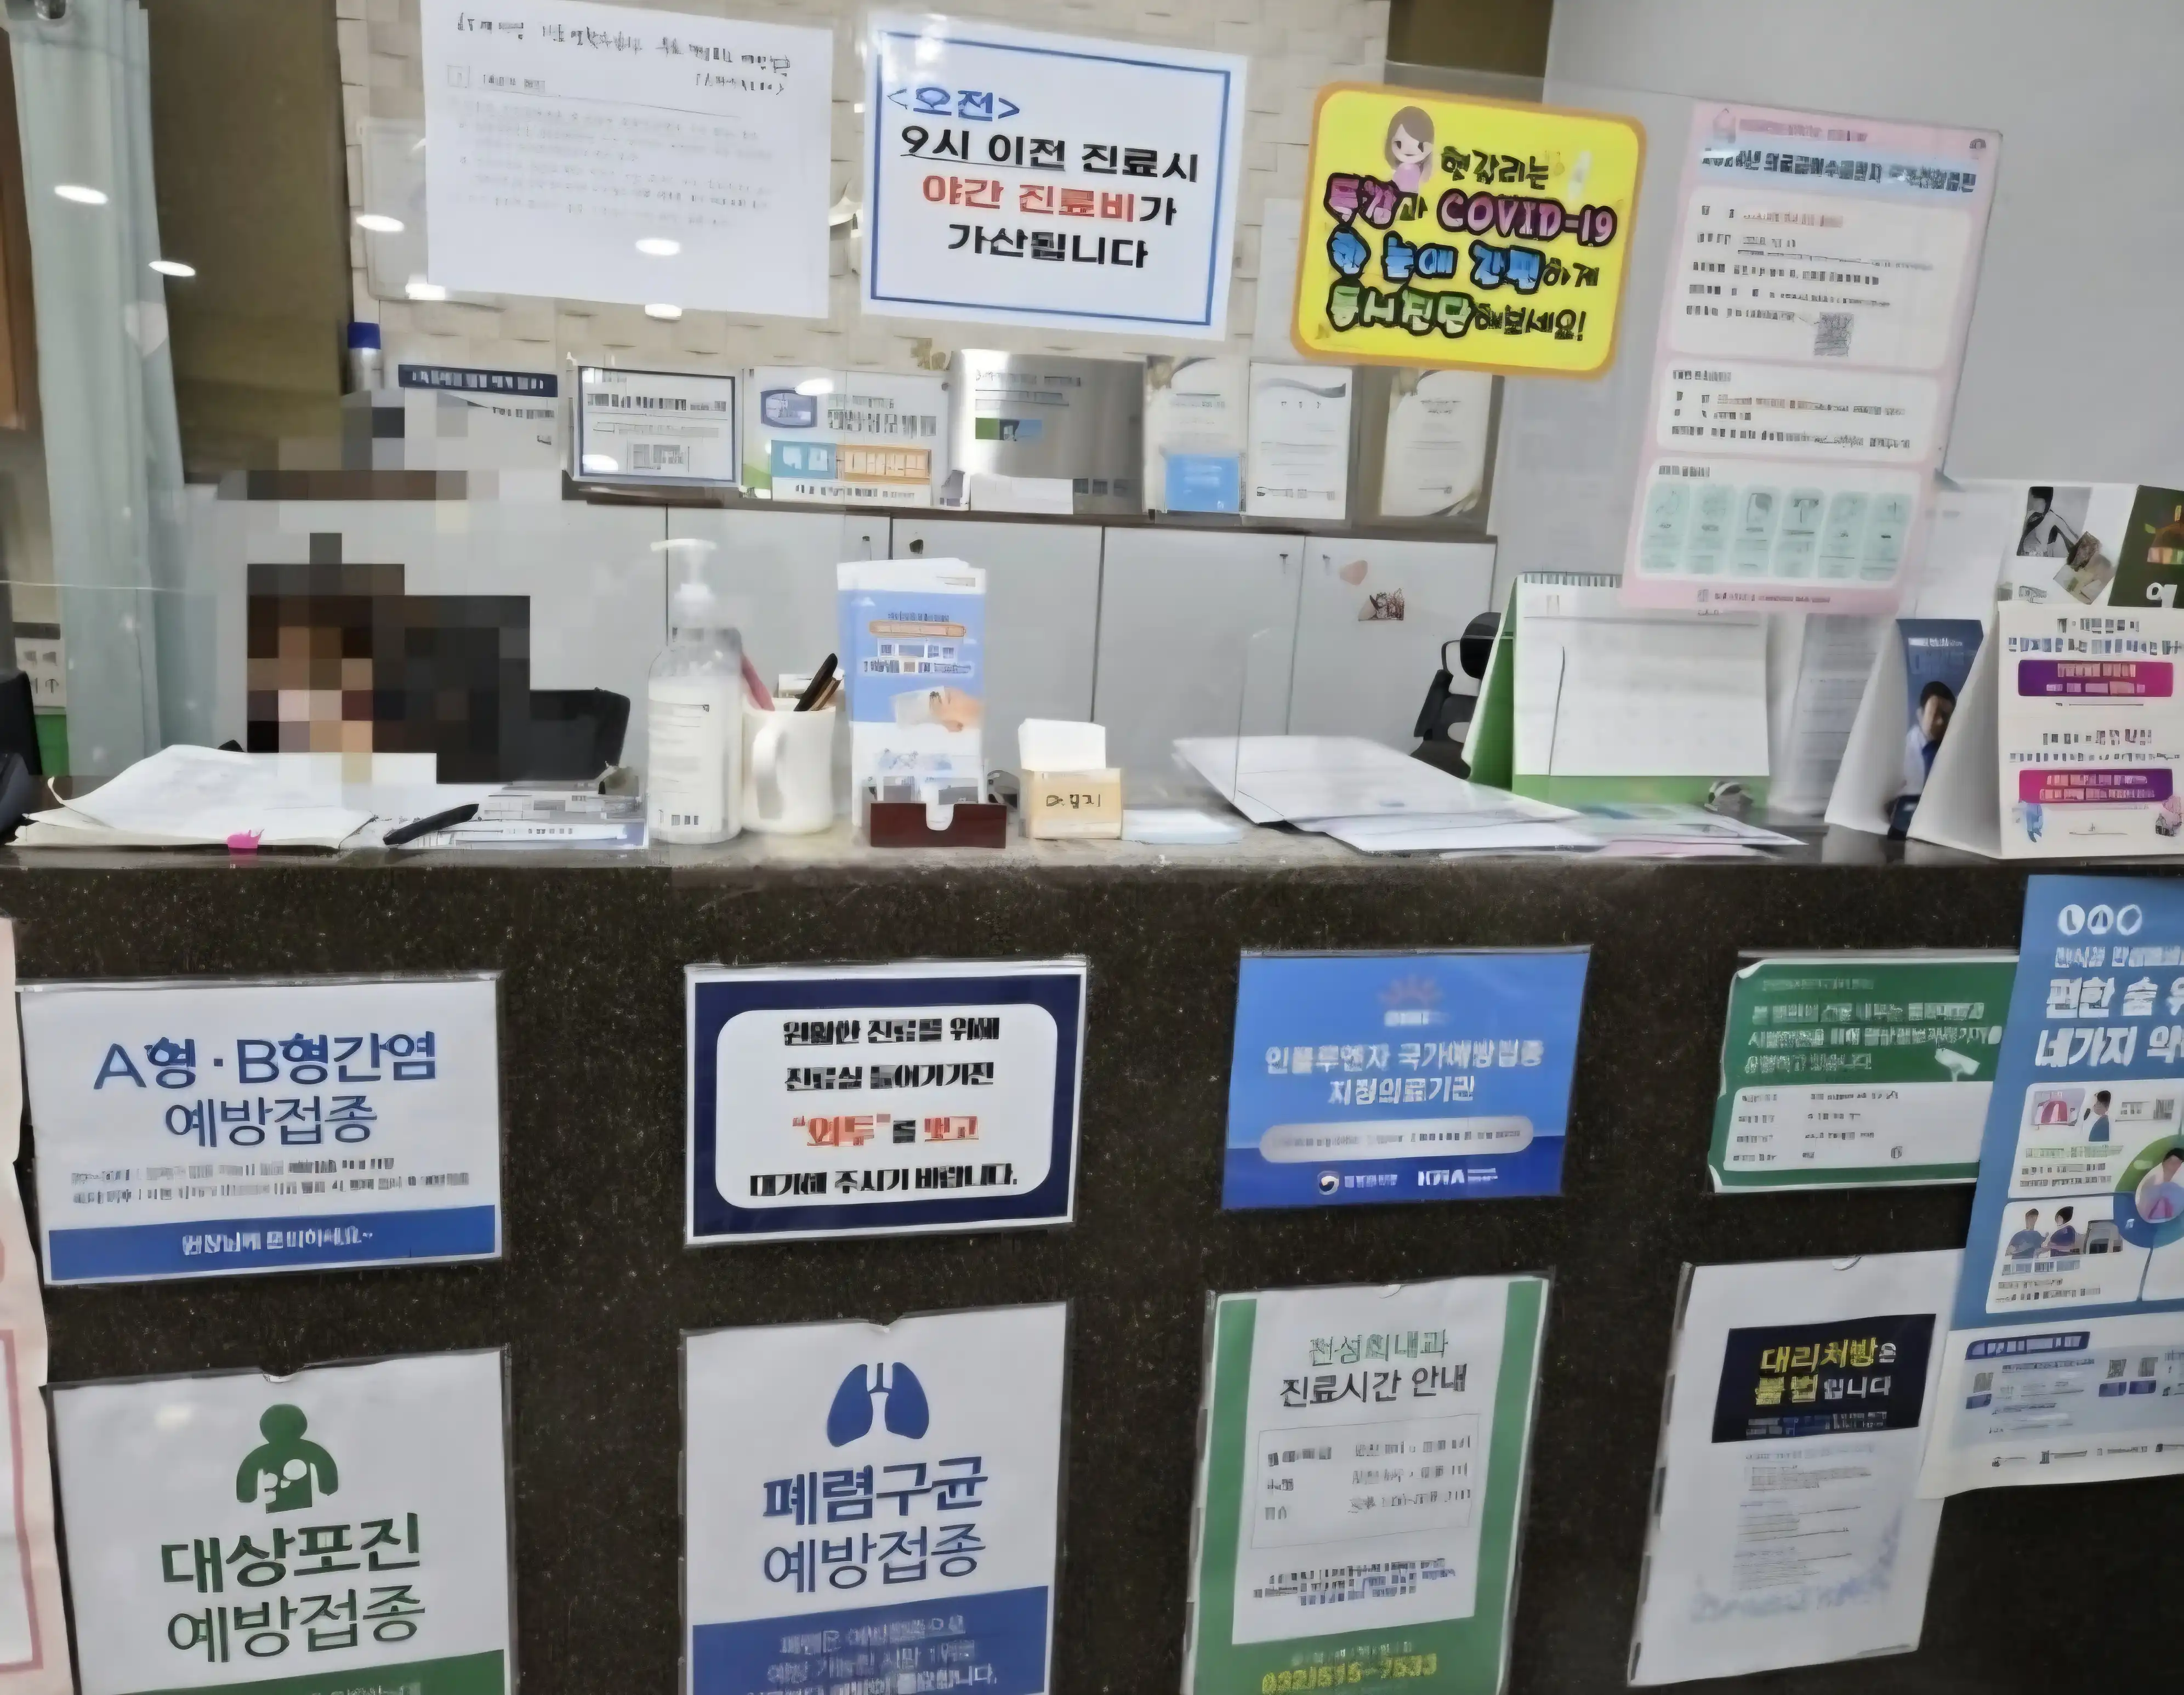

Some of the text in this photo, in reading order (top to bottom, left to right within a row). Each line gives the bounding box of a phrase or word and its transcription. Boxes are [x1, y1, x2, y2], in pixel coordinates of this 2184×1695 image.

[901, 125, 1198, 183] 9시 이전 진료시
[923, 175, 1177, 226] 야간 진료비가
[1437, 189, 1617, 247] COVID-19
[948, 224, 1148, 268] 가산됩니다
[949, 1016, 1000, 1042] 위해
[2034, 1026, 2138, 1068] 네가지
[1265, 1043, 1391, 1075] 인플루엔자
[165, 1095, 377, 1148] 예방접종
[834, 1168, 909, 1195] 주시기
[1760, 1336, 1897, 1373] 대리처방은
[1279, 1363, 1468, 1407] 진료시간 안내
[762, 1455, 989, 1526] 폐렴구균
[161, 1511, 421, 1594] 대상포진
[763, 1523, 987, 1593] 예방접종
[167, 1584, 426, 1663] 예방접종
